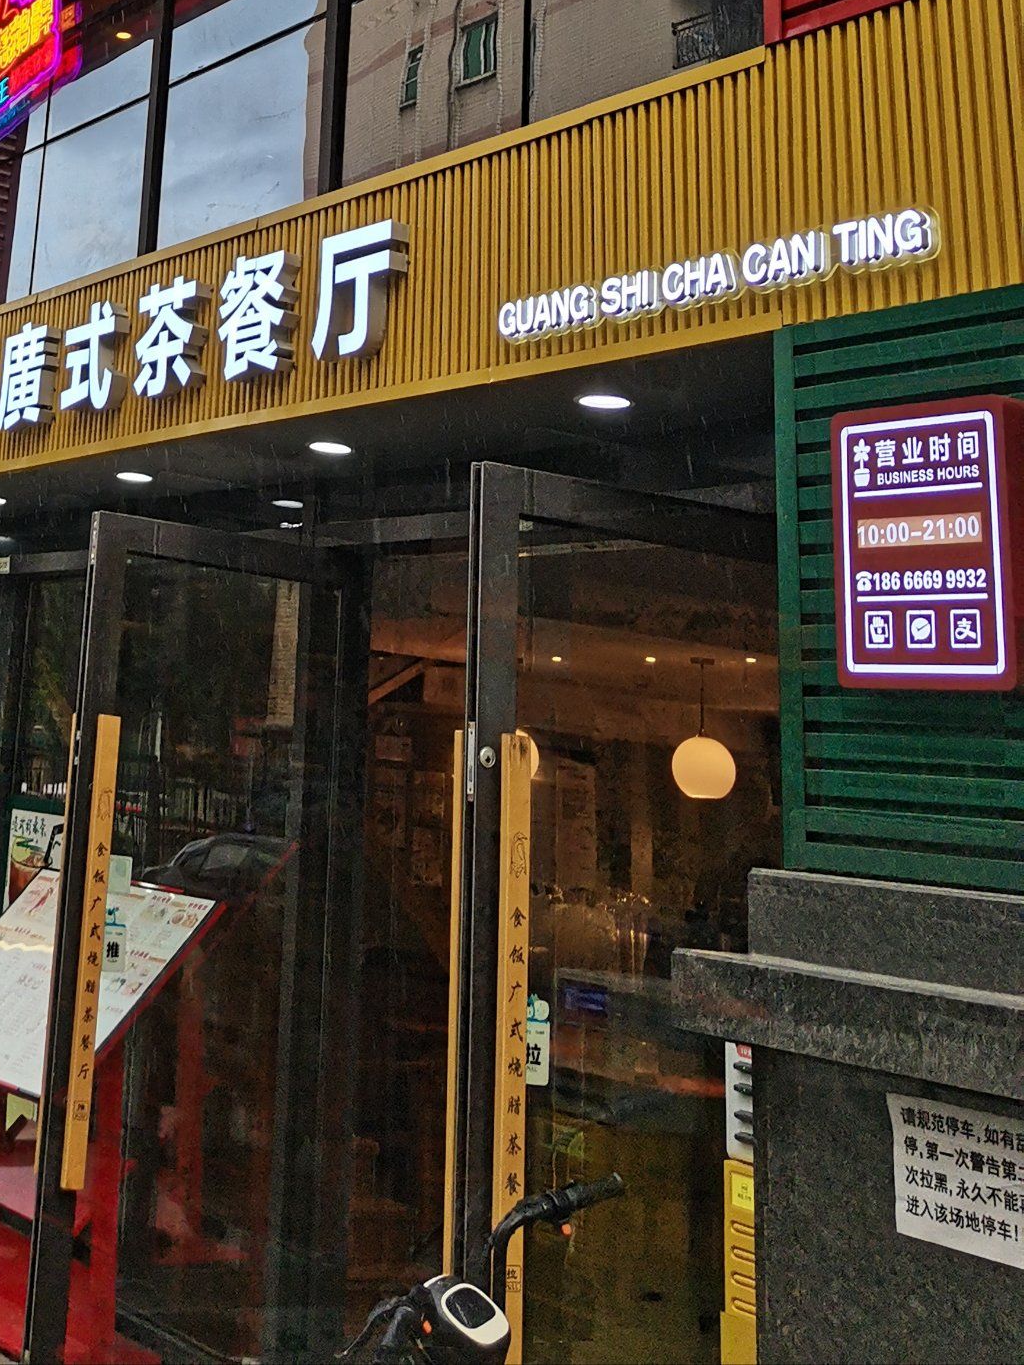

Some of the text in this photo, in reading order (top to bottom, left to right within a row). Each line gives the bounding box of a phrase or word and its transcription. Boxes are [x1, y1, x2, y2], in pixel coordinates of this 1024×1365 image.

[499, 209, 928, 337] GUANG SHI CHA CAN TING
[875, 431, 980, 468] 营业时间
[877, 464, 980, 486] BUSINESS HOURS
[857, 515, 980, 546] 10:00-21:00
[873, 568, 987, 592] 186 6669 9932
[106, 941, 120, 959] 推
